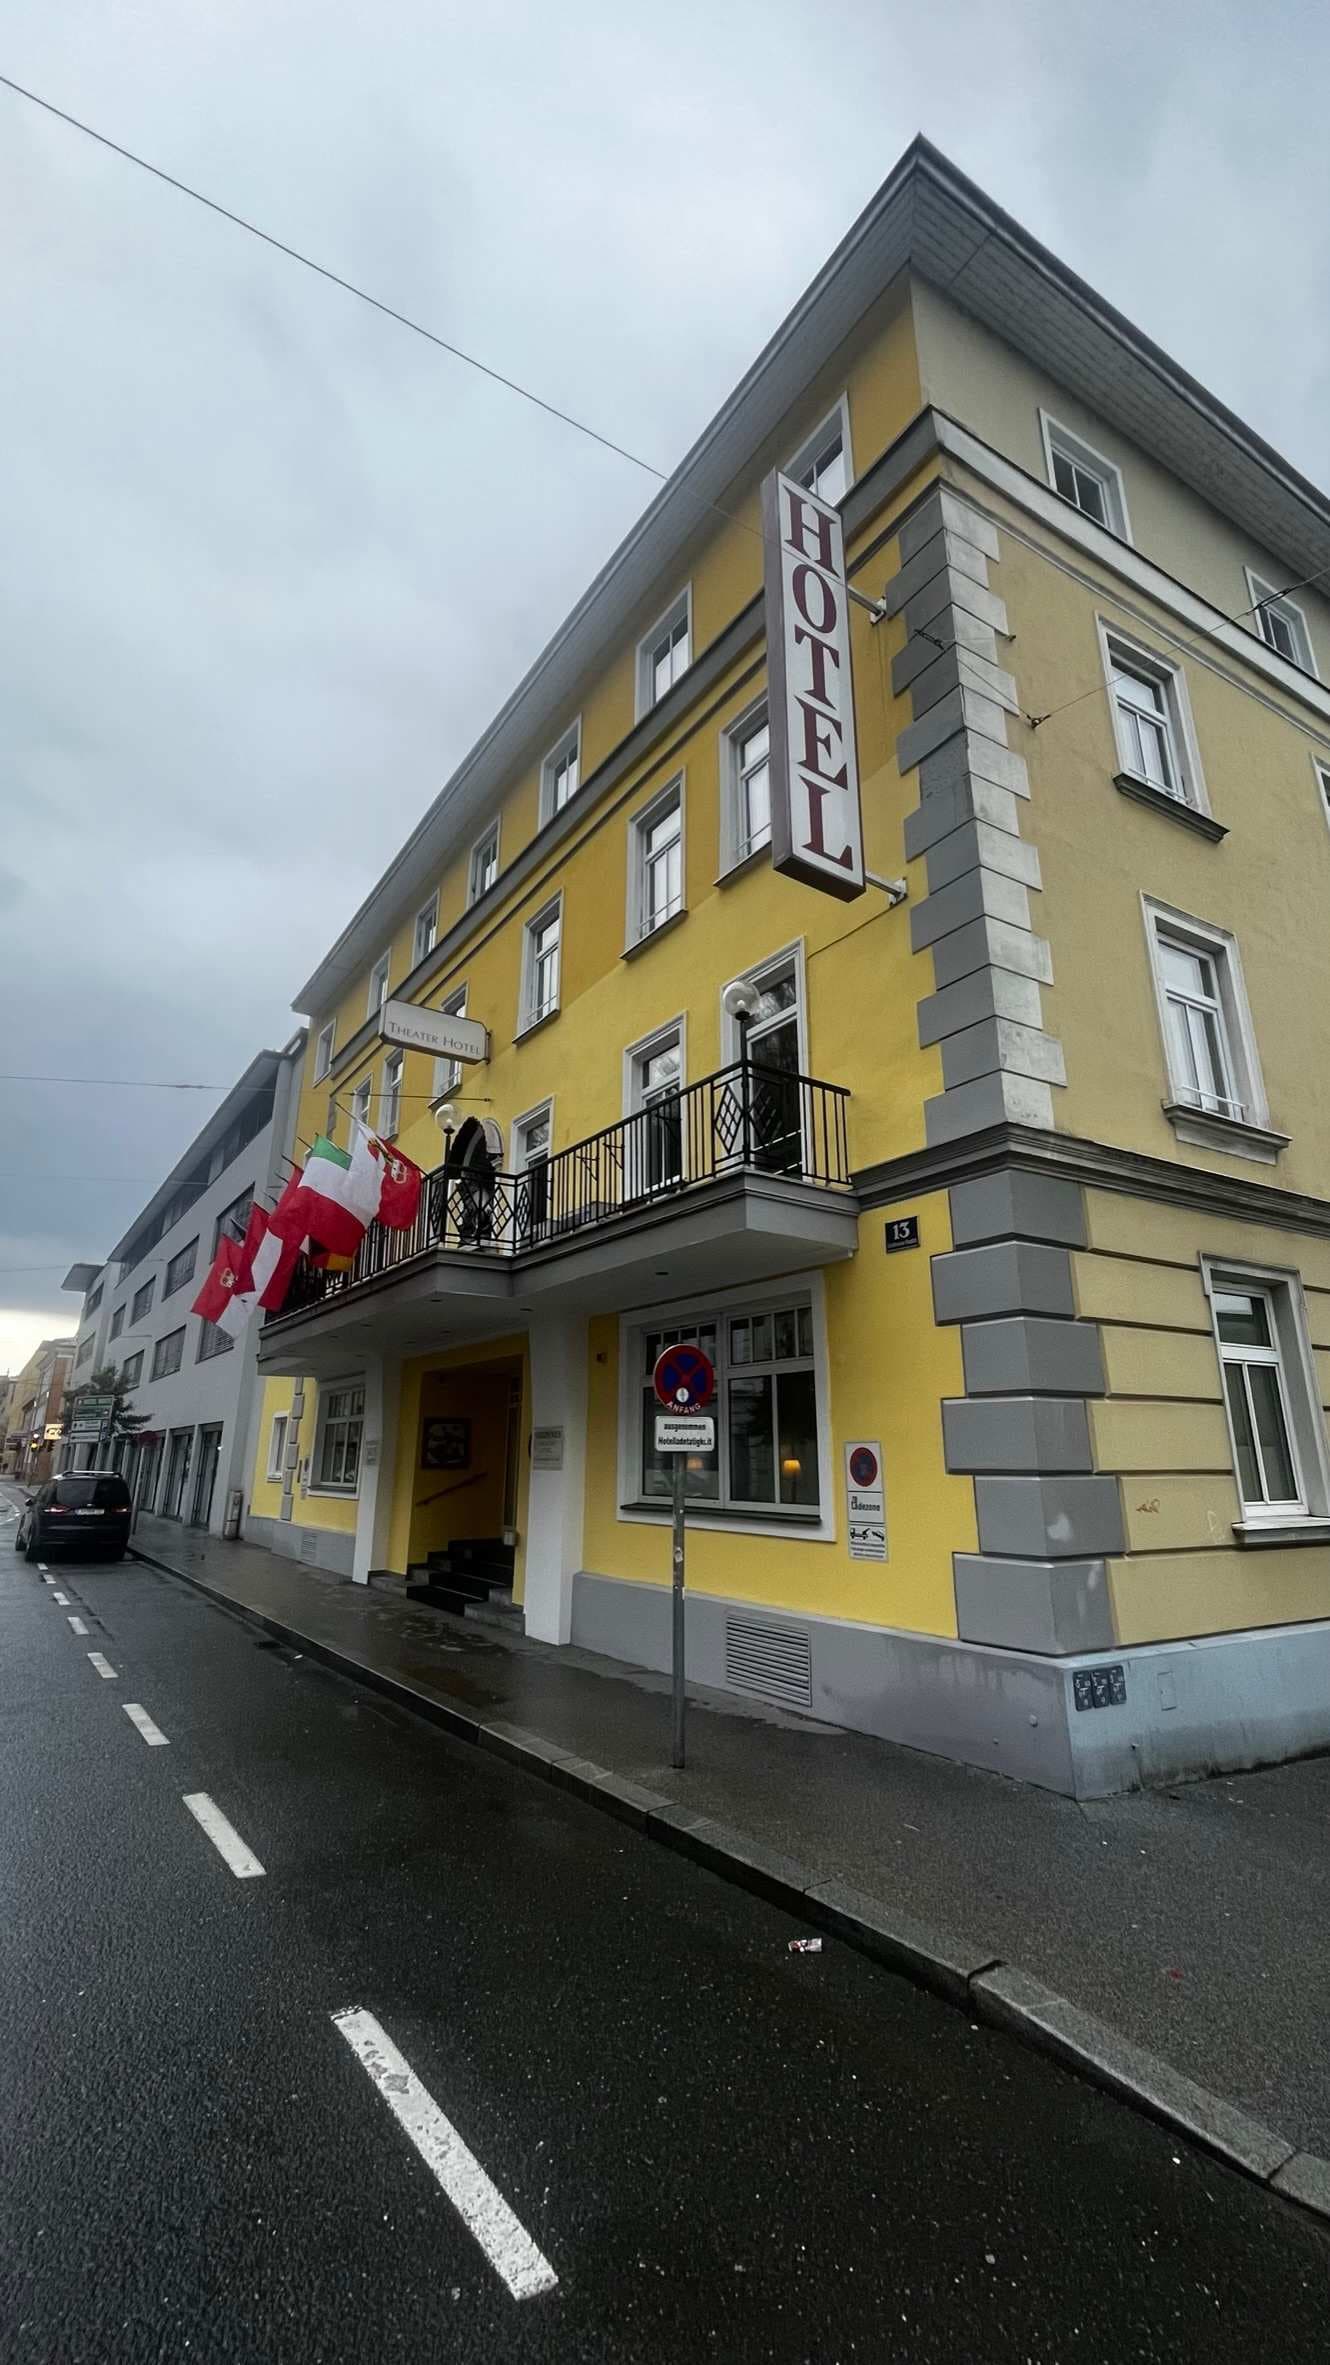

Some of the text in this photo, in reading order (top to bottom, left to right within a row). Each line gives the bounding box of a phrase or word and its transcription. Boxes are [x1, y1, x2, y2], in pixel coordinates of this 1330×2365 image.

[783, 483, 853, 871] HOTEL
[389, 1021, 481, 1056] THEATER HOTEL
[892, 1222, 910, 1240] 13
[667, 1401, 701, 1414] ANFANG
